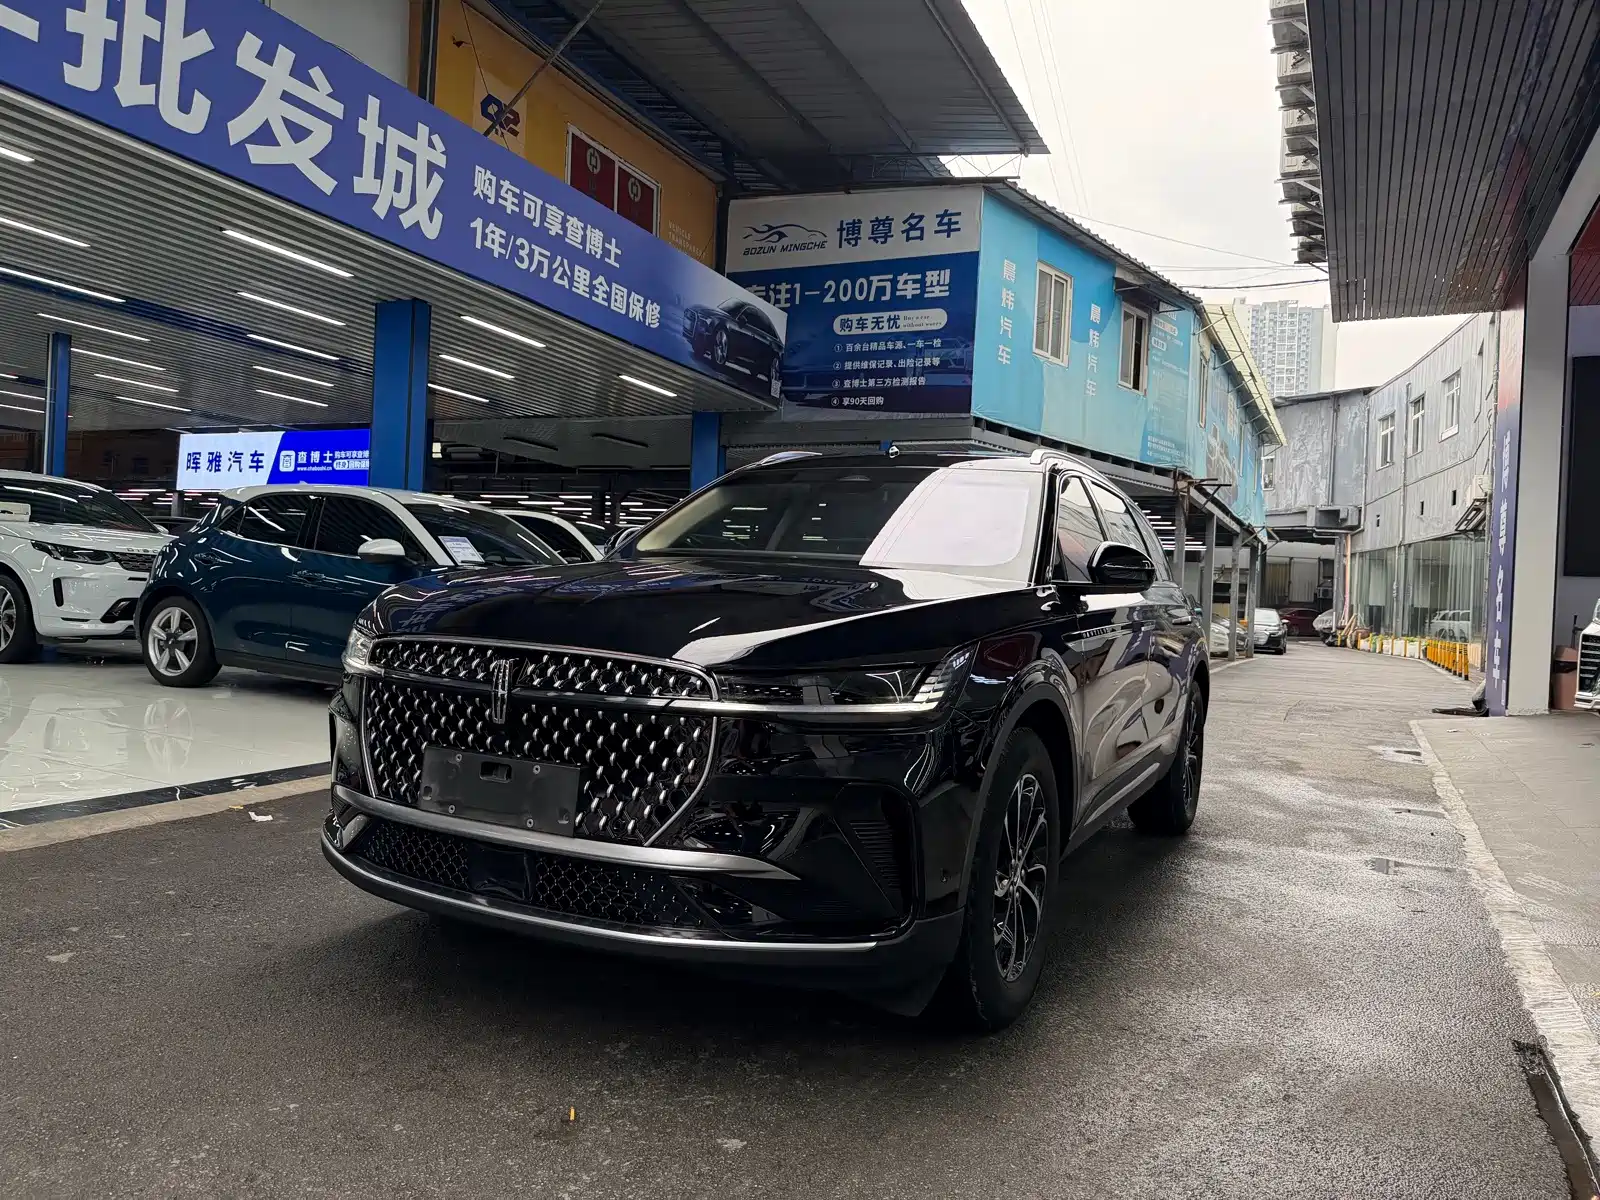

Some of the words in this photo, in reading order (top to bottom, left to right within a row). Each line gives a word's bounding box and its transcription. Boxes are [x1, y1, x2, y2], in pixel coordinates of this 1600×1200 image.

[0, 0, 446, 239] 批发城
[473, 165, 622, 268] 购车可享查博士
[837, 209, 962, 248] 博尊名车
[743, 246, 776, 256] BOZUN
[780, 241, 828, 253] MINGCHE
[470, 217, 660, 328] 1年/3万公里全国保修
[839, 314, 901, 332] 购车无忧
[843, 376, 926, 388] 查博士第三方检测报告
[842, 396, 884, 406] 享90天回购
[185, 450, 265, 473] 晖雅汽车
[297, 450, 333, 463] 查博士
